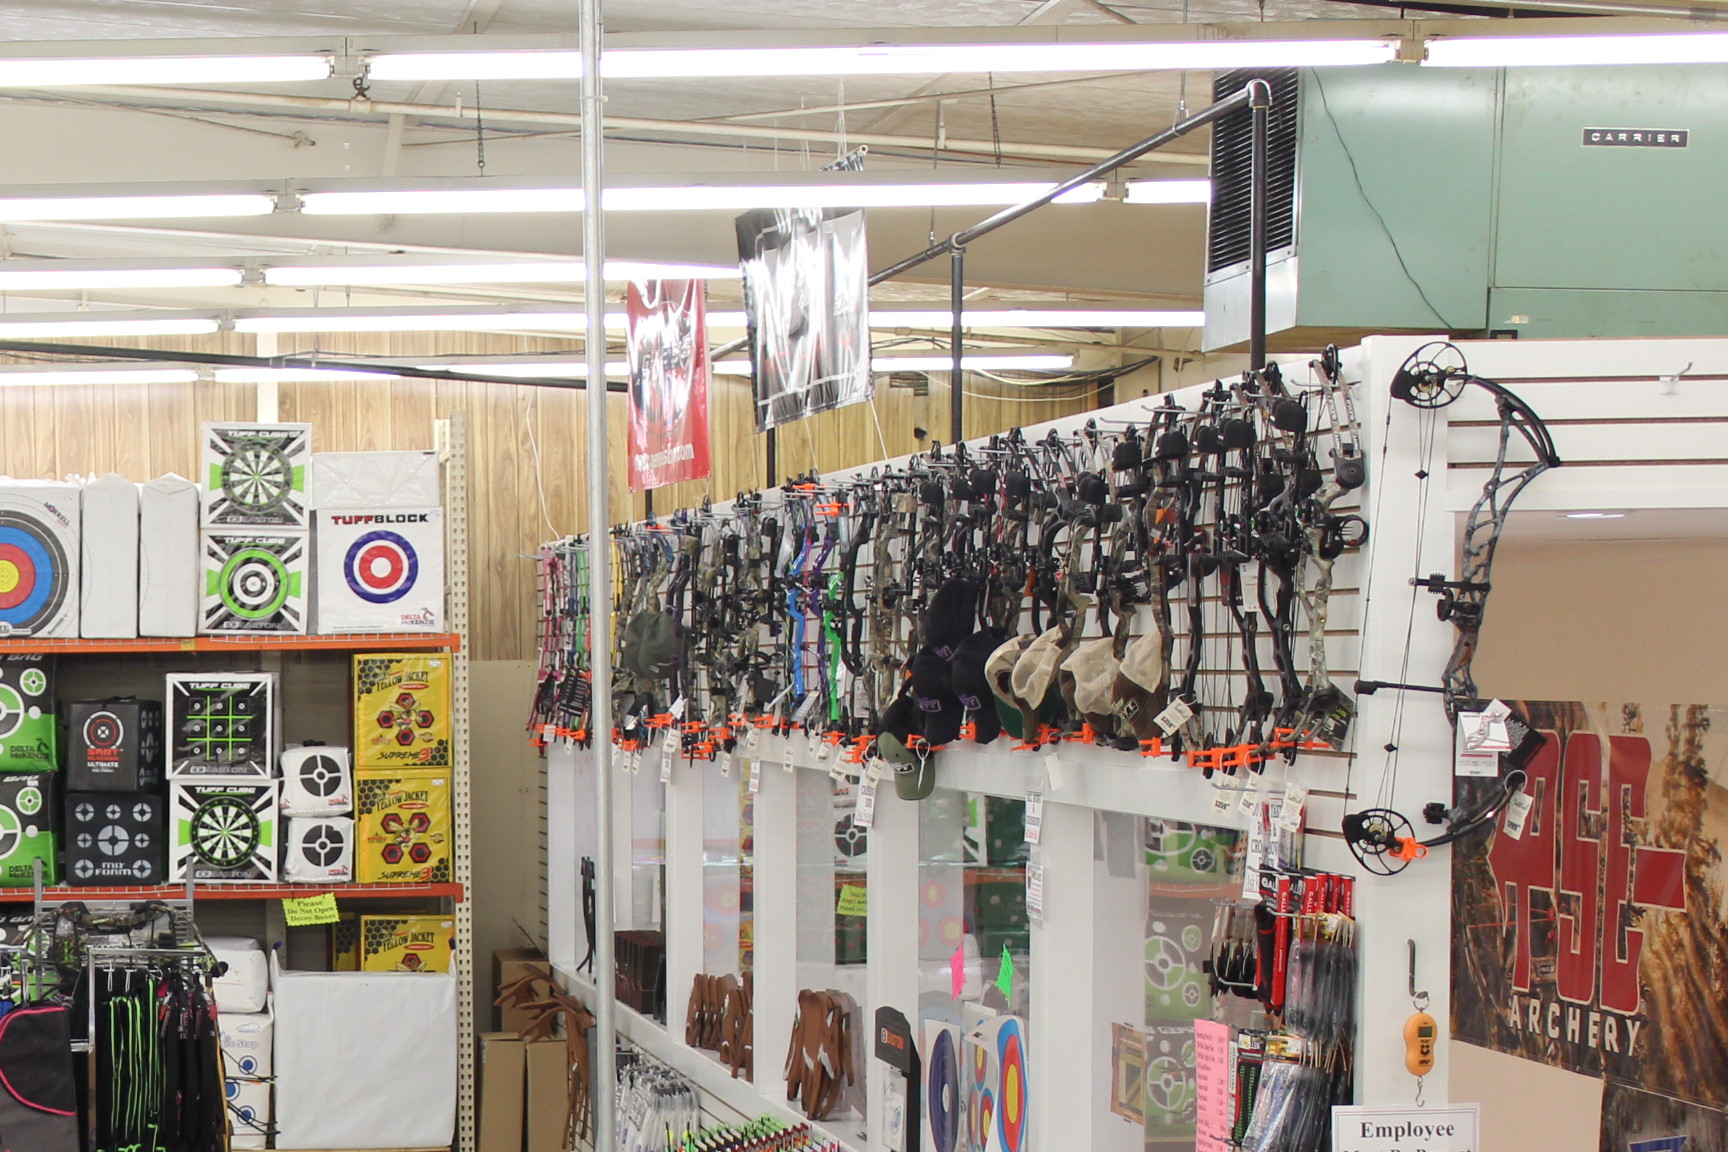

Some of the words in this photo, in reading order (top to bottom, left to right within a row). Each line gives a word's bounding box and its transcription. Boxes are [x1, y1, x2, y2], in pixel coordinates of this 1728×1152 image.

[1591, 132, 1680, 143] CARRIER
[331, 513, 429, 525] TUFFBLOCK
[224, 536, 253, 544] TUFF
[255, 536, 285, 544] CUBE
[7, 653, 43, 662] BAG
[376, 675, 402, 691] YELLOW
[403, 671, 429, 682] JACKET
[189, 682, 223, 690] TUFF
[10, 751, 49, 760] McKENZIE
[3, 774, 40, 783] BAG
[195, 786, 225, 794] TUFF
[227, 786, 256, 794] CUBE
[376, 794, 402, 811] YELLOW
[403, 791, 429, 802] JACKET
[314, 906, 334, 914] Open
[10, 915, 35, 923] BA
[382, 935, 409, 952] YELLOW
[410, 931, 435, 944] JACKET
[1508, 1000, 1642, 1057] ARCHERY
[1360, 1121, 1455, 1142] Employee
